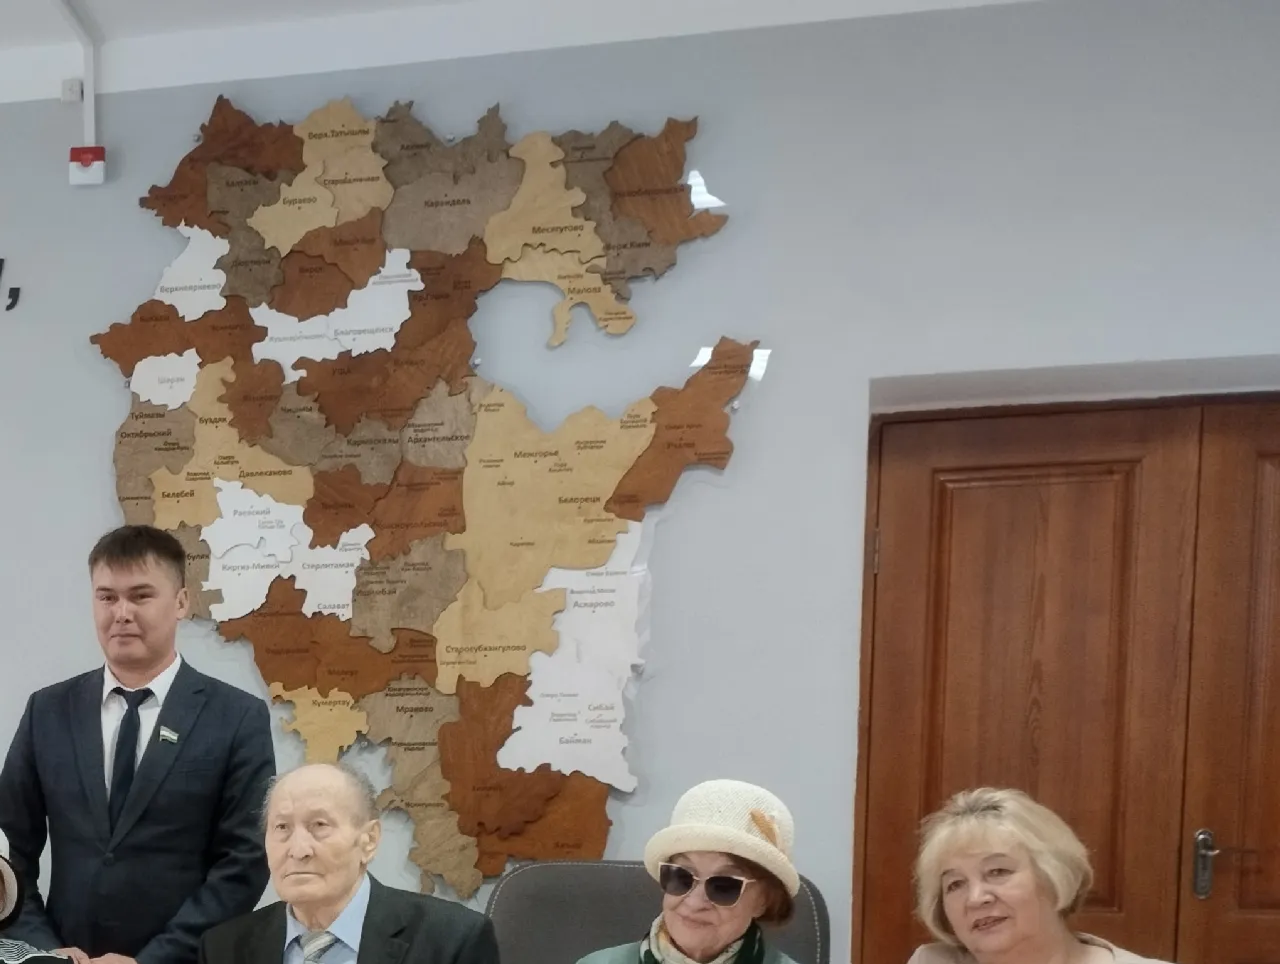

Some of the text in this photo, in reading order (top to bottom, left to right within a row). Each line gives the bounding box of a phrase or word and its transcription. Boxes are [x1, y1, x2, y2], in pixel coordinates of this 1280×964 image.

[120, 429, 173, 441] Октябрьский
[407, 434, 472, 445] Архангельское
[238, 470, 294, 480] Давлеканово
[161, 489, 196, 499] Белебей
[186, 552, 210, 563] буляк
[301, 561, 356, 572] Стерлитамак
[316, 602, 350, 611] Салават
[572, 600, 616, 610] Аскарово
